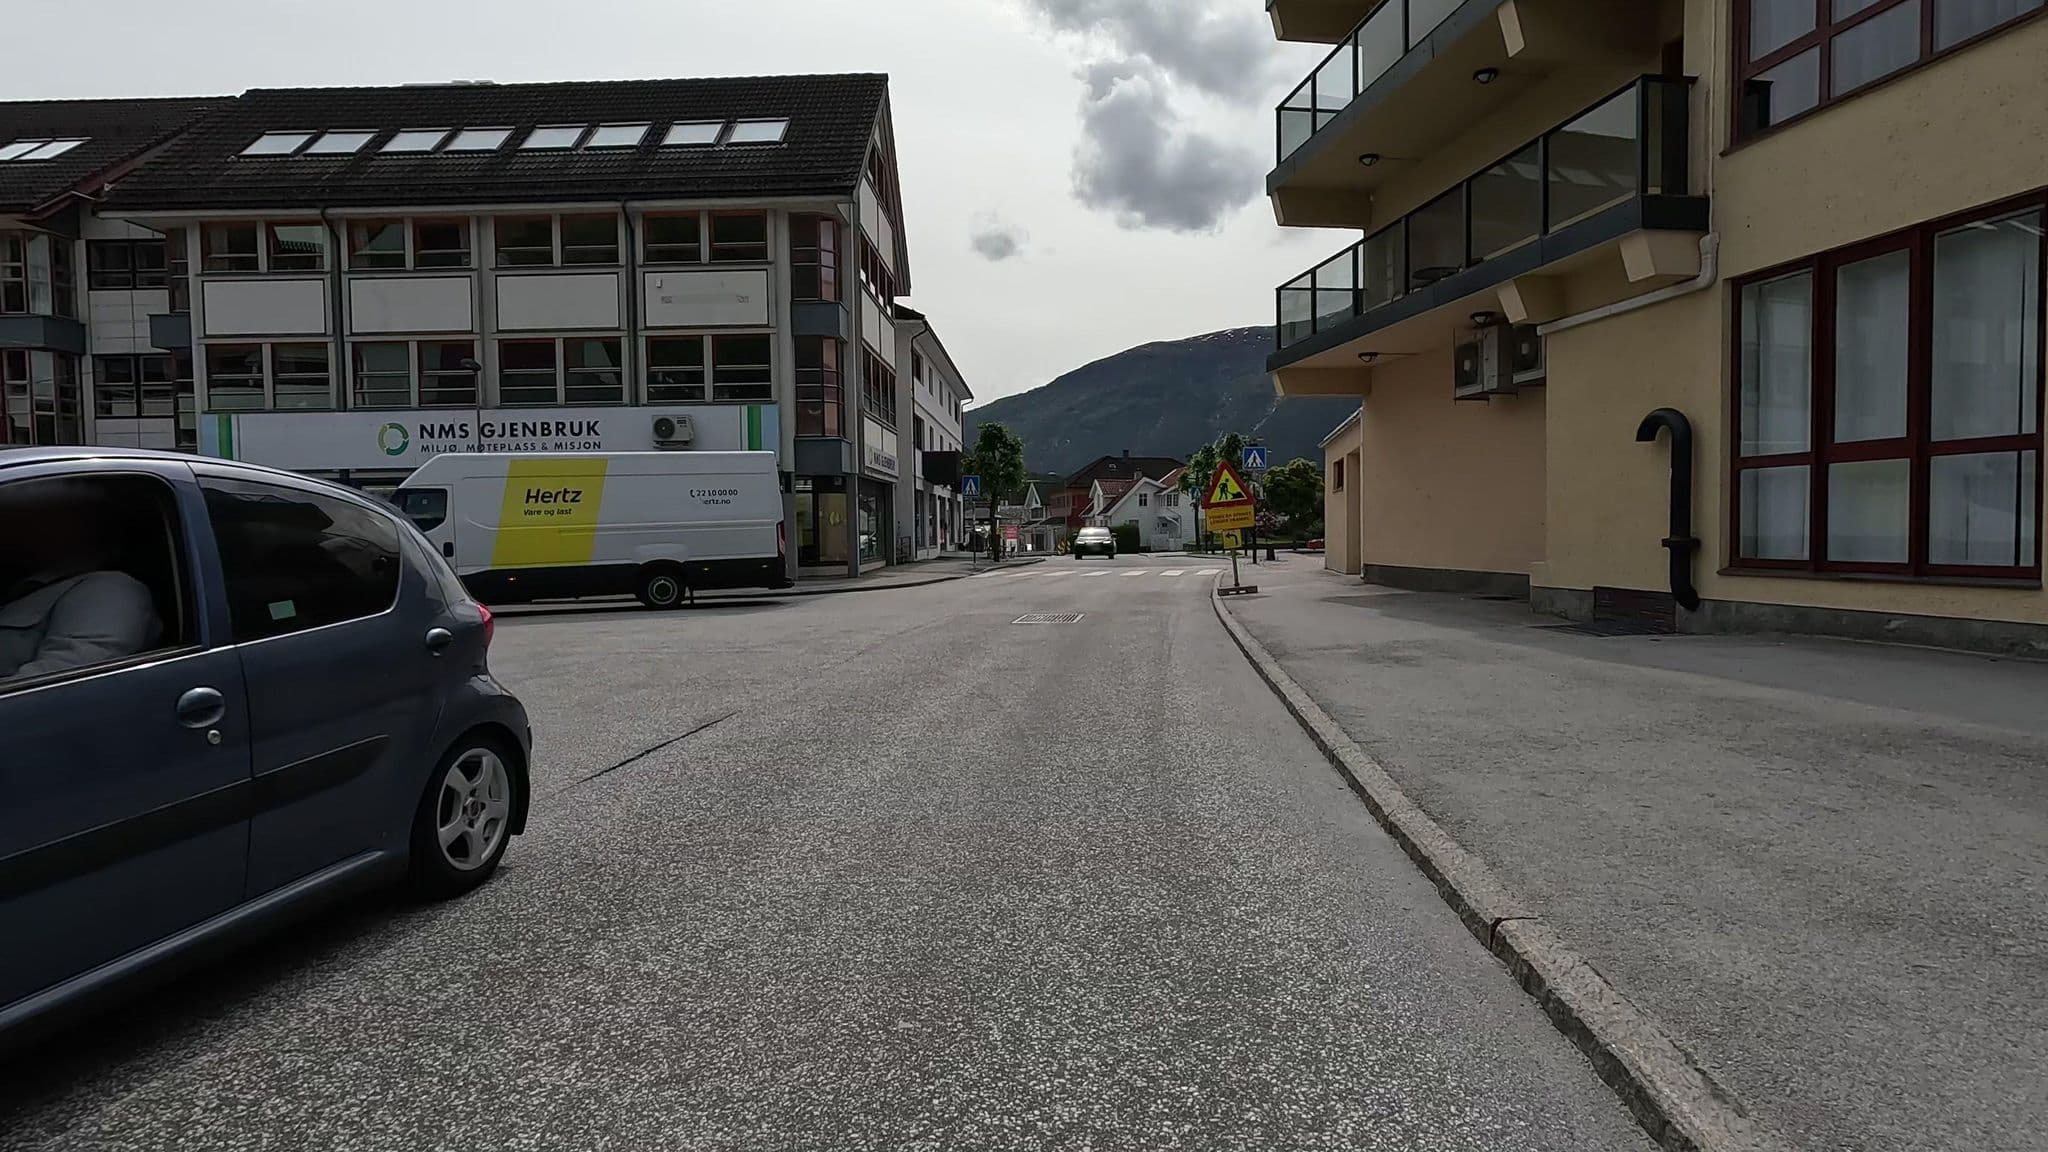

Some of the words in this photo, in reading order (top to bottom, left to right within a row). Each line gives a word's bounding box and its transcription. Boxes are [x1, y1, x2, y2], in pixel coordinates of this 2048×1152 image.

[419, 422, 470, 440] NMS
[480, 421, 600, 438] GJENBRUK
[466, 441, 537, 452] MØTEPLASS
[541, 442, 549, 451] &
[554, 441, 601, 450] MISJON
[525, 488, 582, 504] Hertz
[523, 508, 541, 516] Vare
[544, 509, 555, 517] og
[556, 507, 573, 516] last
